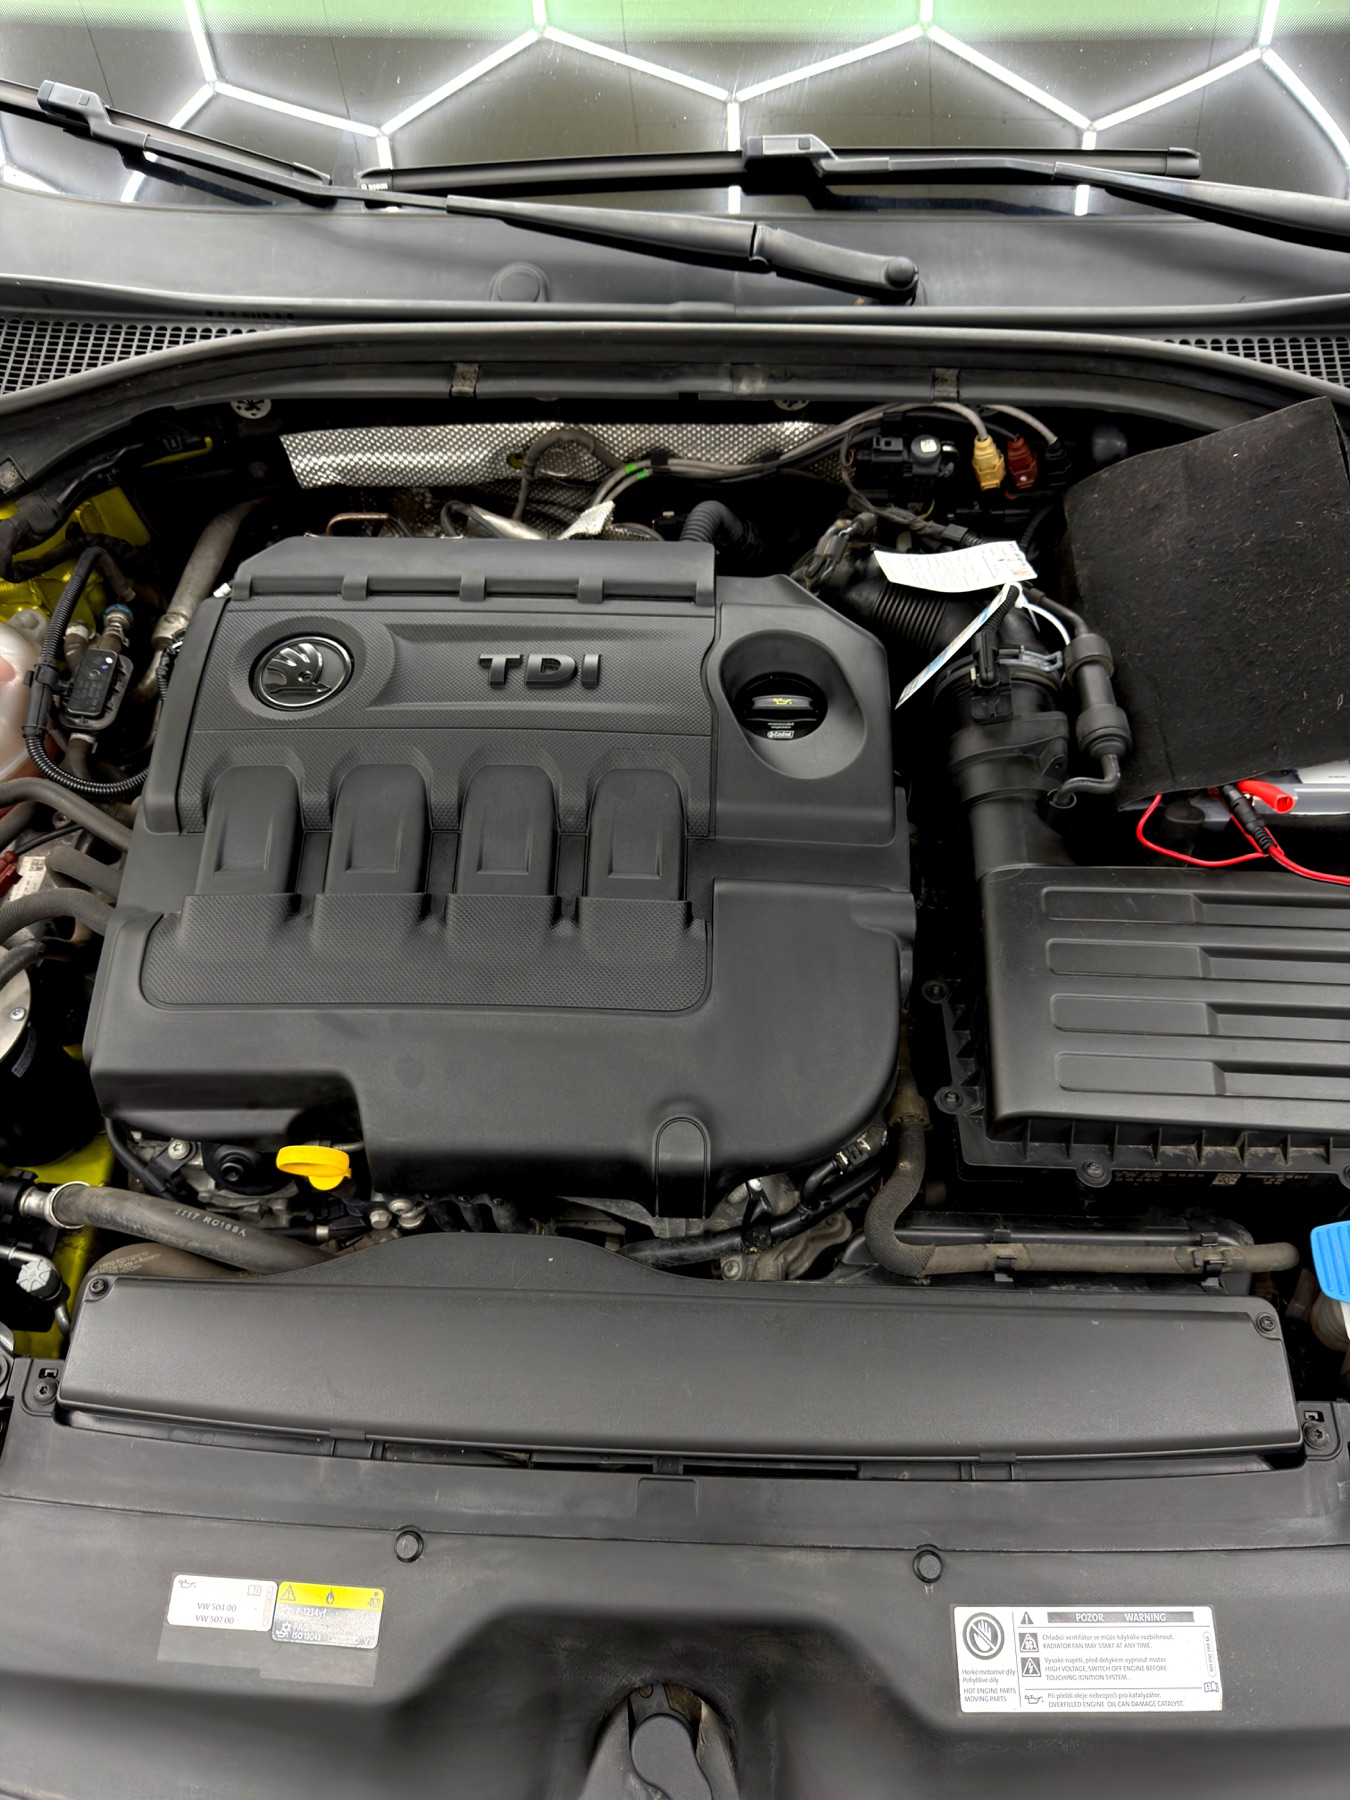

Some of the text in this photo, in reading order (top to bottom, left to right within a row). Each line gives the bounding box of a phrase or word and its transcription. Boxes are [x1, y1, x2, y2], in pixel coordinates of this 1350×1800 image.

[479, 653, 602, 688] TDI
[197, 1602, 237, 1612] VW 504 00
[195, 1614, 235, 1624] VW 507 00
[1075, 1612, 1166, 1622] POZOR WARNING
[1074, 1692, 1088, 1700] oleje
